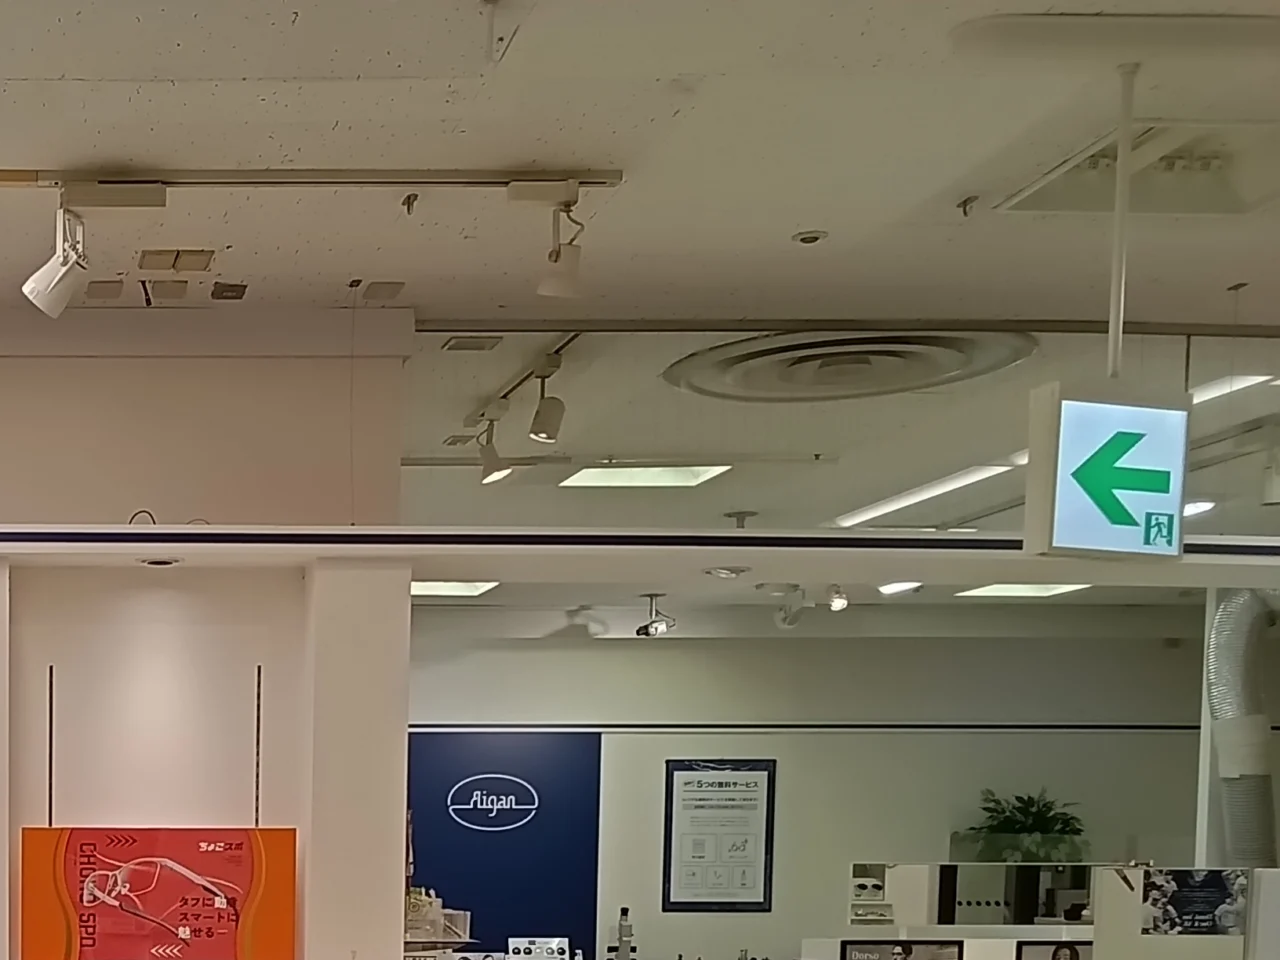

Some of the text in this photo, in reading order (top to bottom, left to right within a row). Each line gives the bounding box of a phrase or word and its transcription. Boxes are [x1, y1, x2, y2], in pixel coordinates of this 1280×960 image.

[470, 790, 516, 817] Aigan
[199, 842, 244, 851] ちょこスポ
[179, 912, 238, 923] スマートに
[80, 912, 97, 948] SPO
